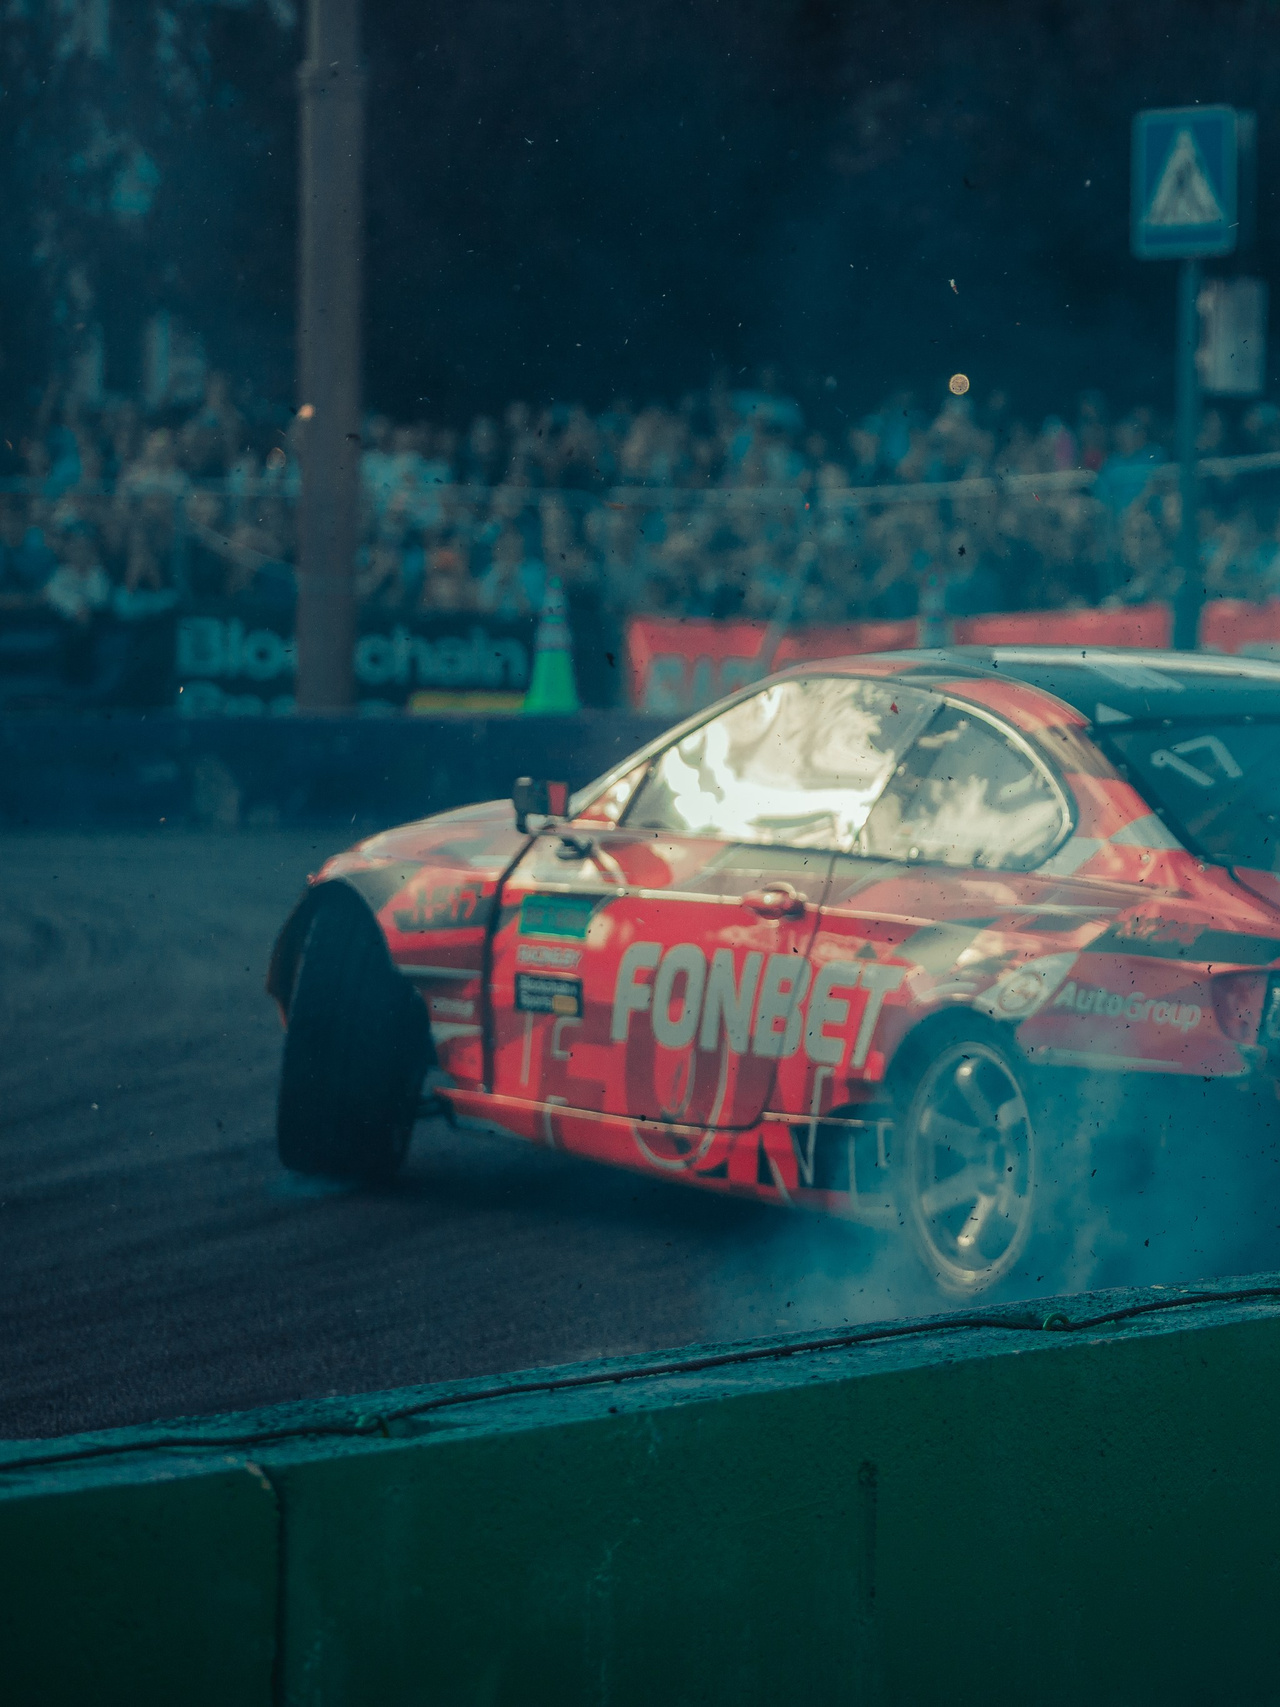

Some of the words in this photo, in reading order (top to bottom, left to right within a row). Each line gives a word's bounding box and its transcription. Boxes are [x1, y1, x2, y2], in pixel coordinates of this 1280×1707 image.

[177, 616, 528, 684] Blochain
[1151, 735, 1243, 786] 17
[611, 941, 907, 1069] FONBET
[1051, 981, 1201, 1032] AutoGroup
